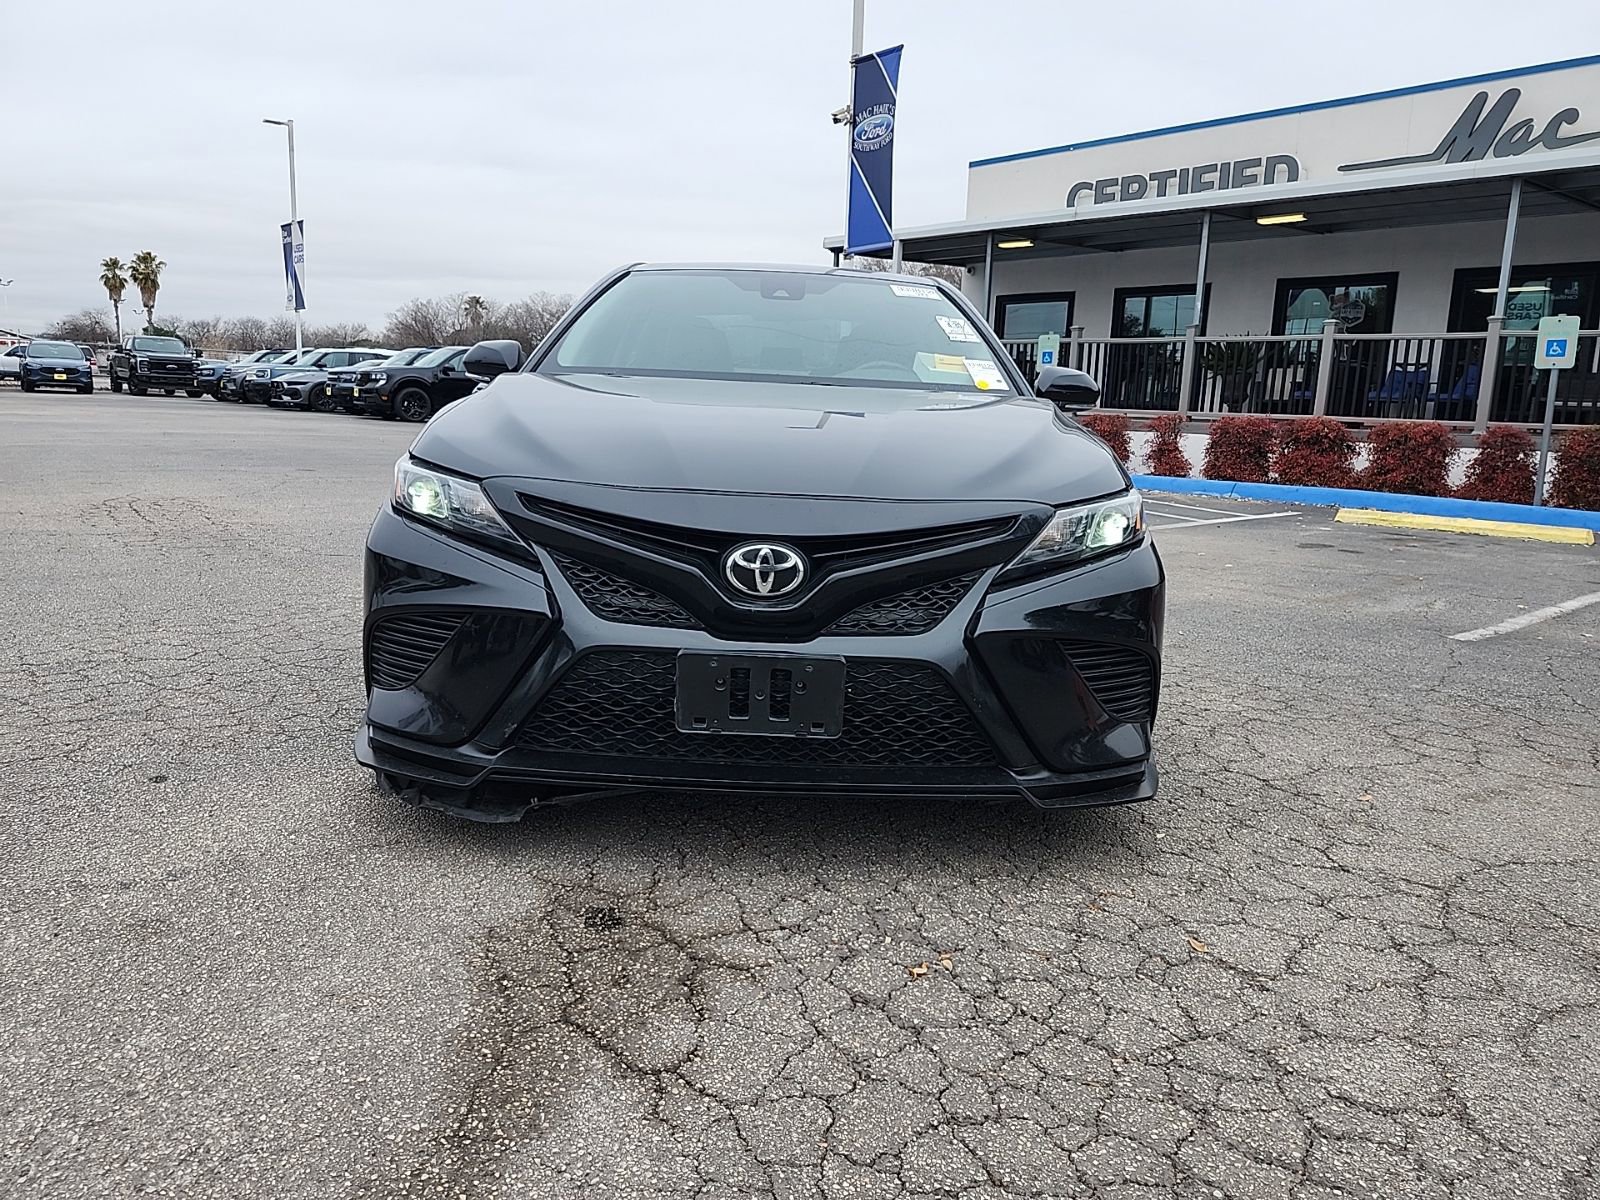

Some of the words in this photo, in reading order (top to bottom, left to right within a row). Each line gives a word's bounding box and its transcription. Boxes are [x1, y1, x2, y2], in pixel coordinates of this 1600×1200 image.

[856, 107, 872, 124] MAC
[873, 104, 895, 115] HAIK'S
[861, 120, 887, 139] Ford
[1338, 88, 1600, 171] Mac
[854, 141, 880, 151] SOUTHWAY
[881, 132, 892, 147] FORD
[1066, 154, 1299, 208] CERTIFIED
[294, 243, 304, 253] USED
[294, 254, 304, 264] CARS
